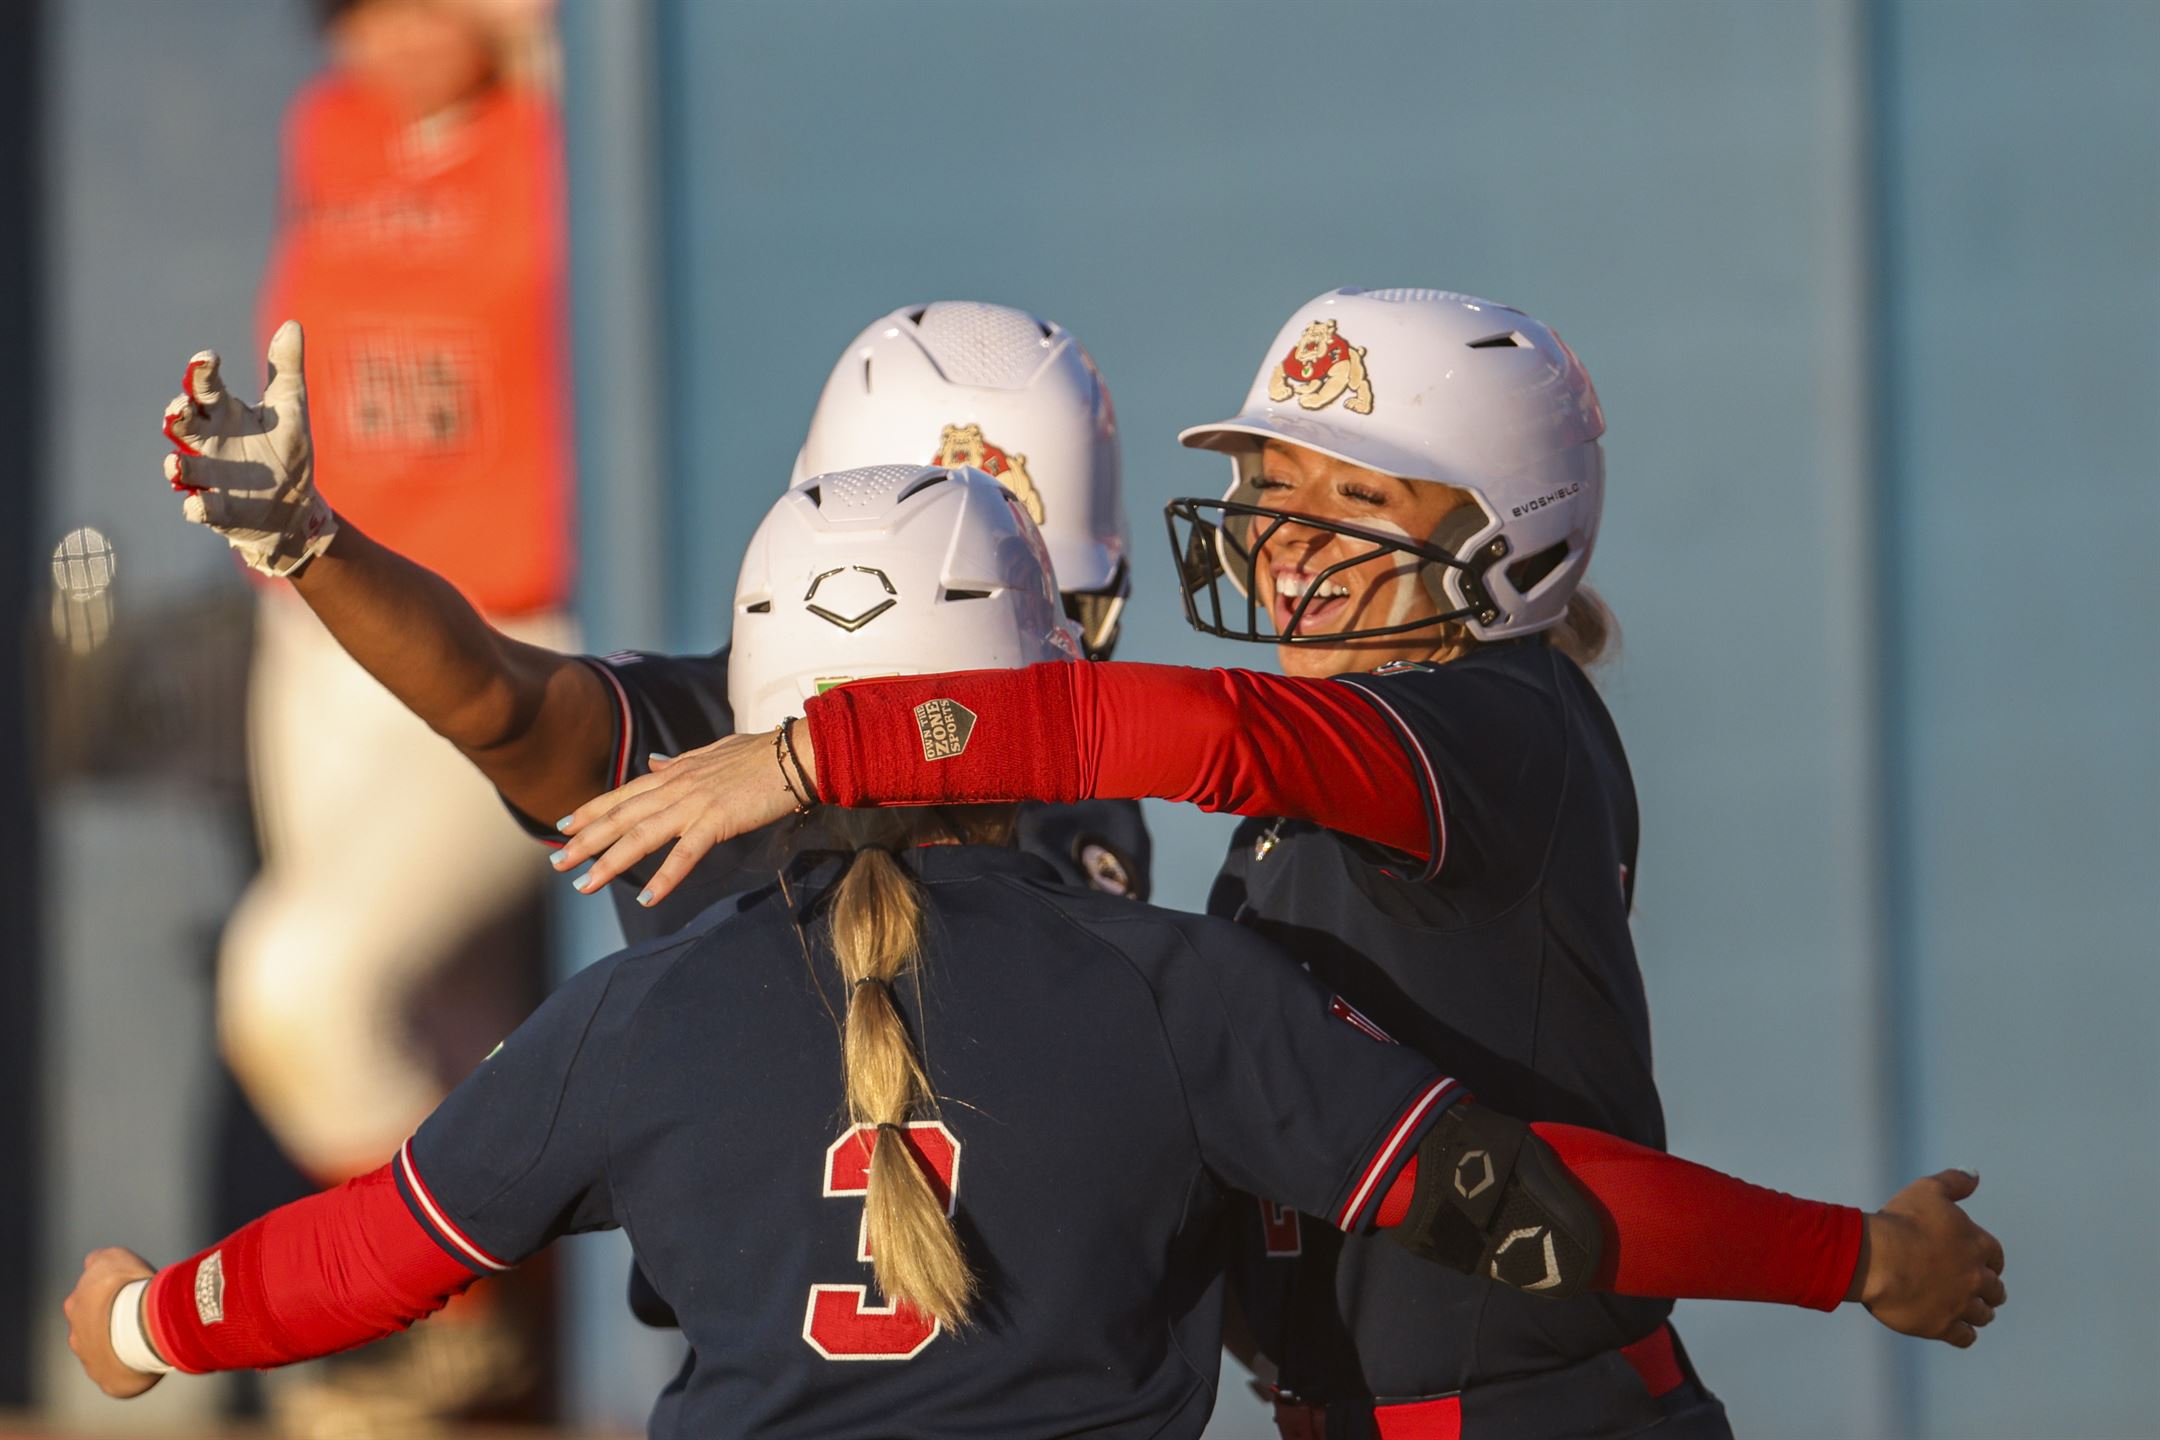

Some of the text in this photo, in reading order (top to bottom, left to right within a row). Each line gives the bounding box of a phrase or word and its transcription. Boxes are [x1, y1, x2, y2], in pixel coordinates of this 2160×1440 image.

[1512, 483, 1579, 517] EVOSHIELD
[916, 705, 936, 758] OWN THE
[925, 701, 950, 756] ZONE
[940, 700, 961, 752] SPORTS
[803, 1120, 961, 1360] 3
